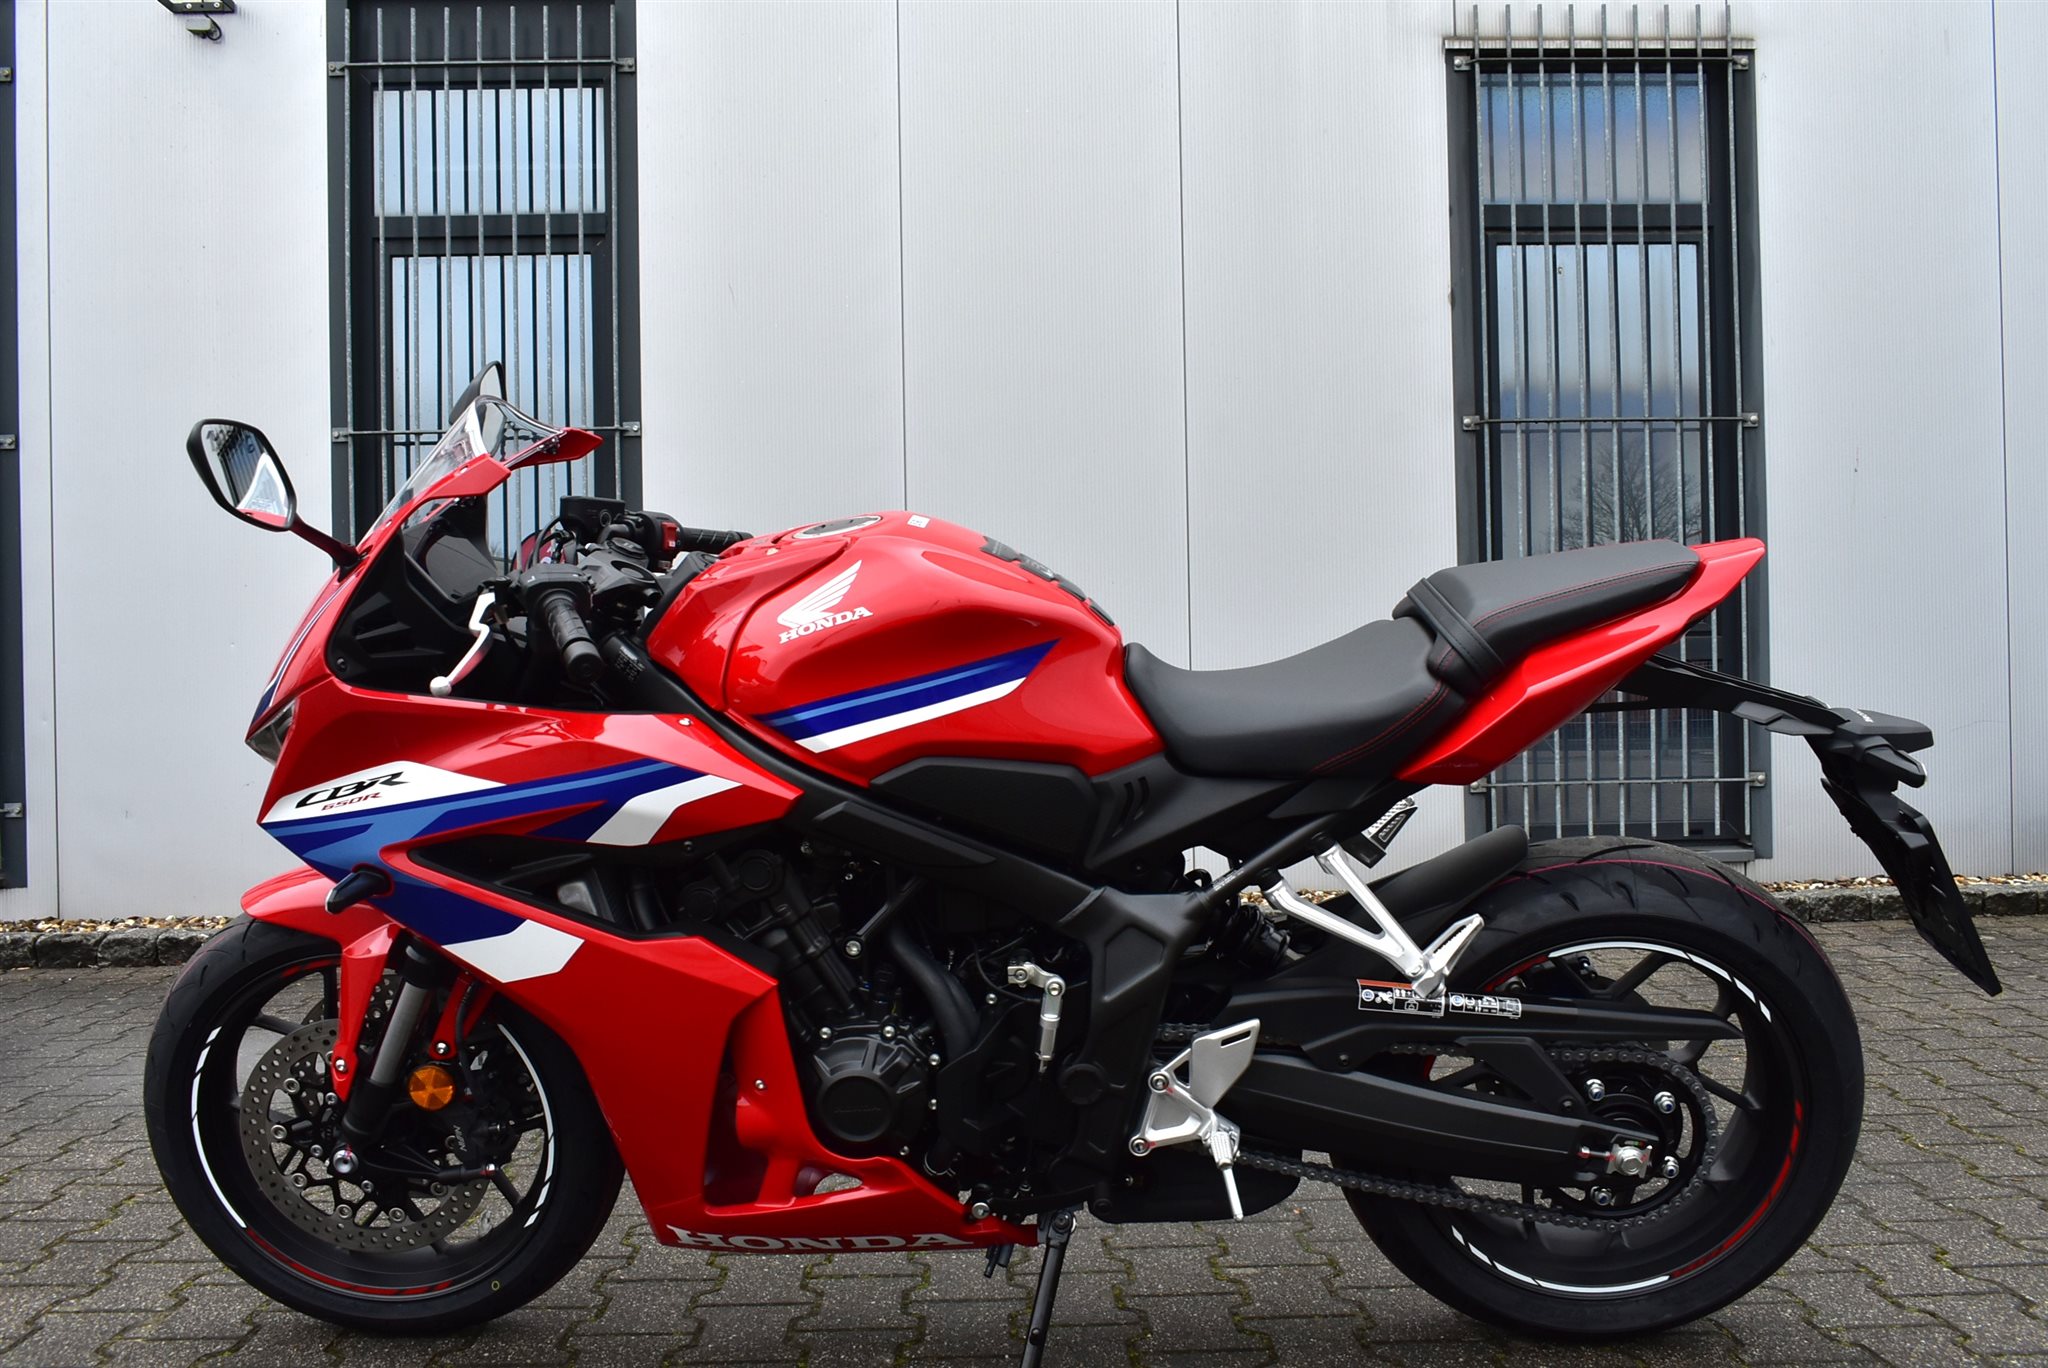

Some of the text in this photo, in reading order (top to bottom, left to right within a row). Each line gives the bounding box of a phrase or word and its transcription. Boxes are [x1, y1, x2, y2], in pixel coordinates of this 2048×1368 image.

[778, 606, 873, 644] HONDA
[295, 771, 410, 809] CBR
[321, 791, 382, 811] 650R
[665, 1224, 974, 1250] HONDA
